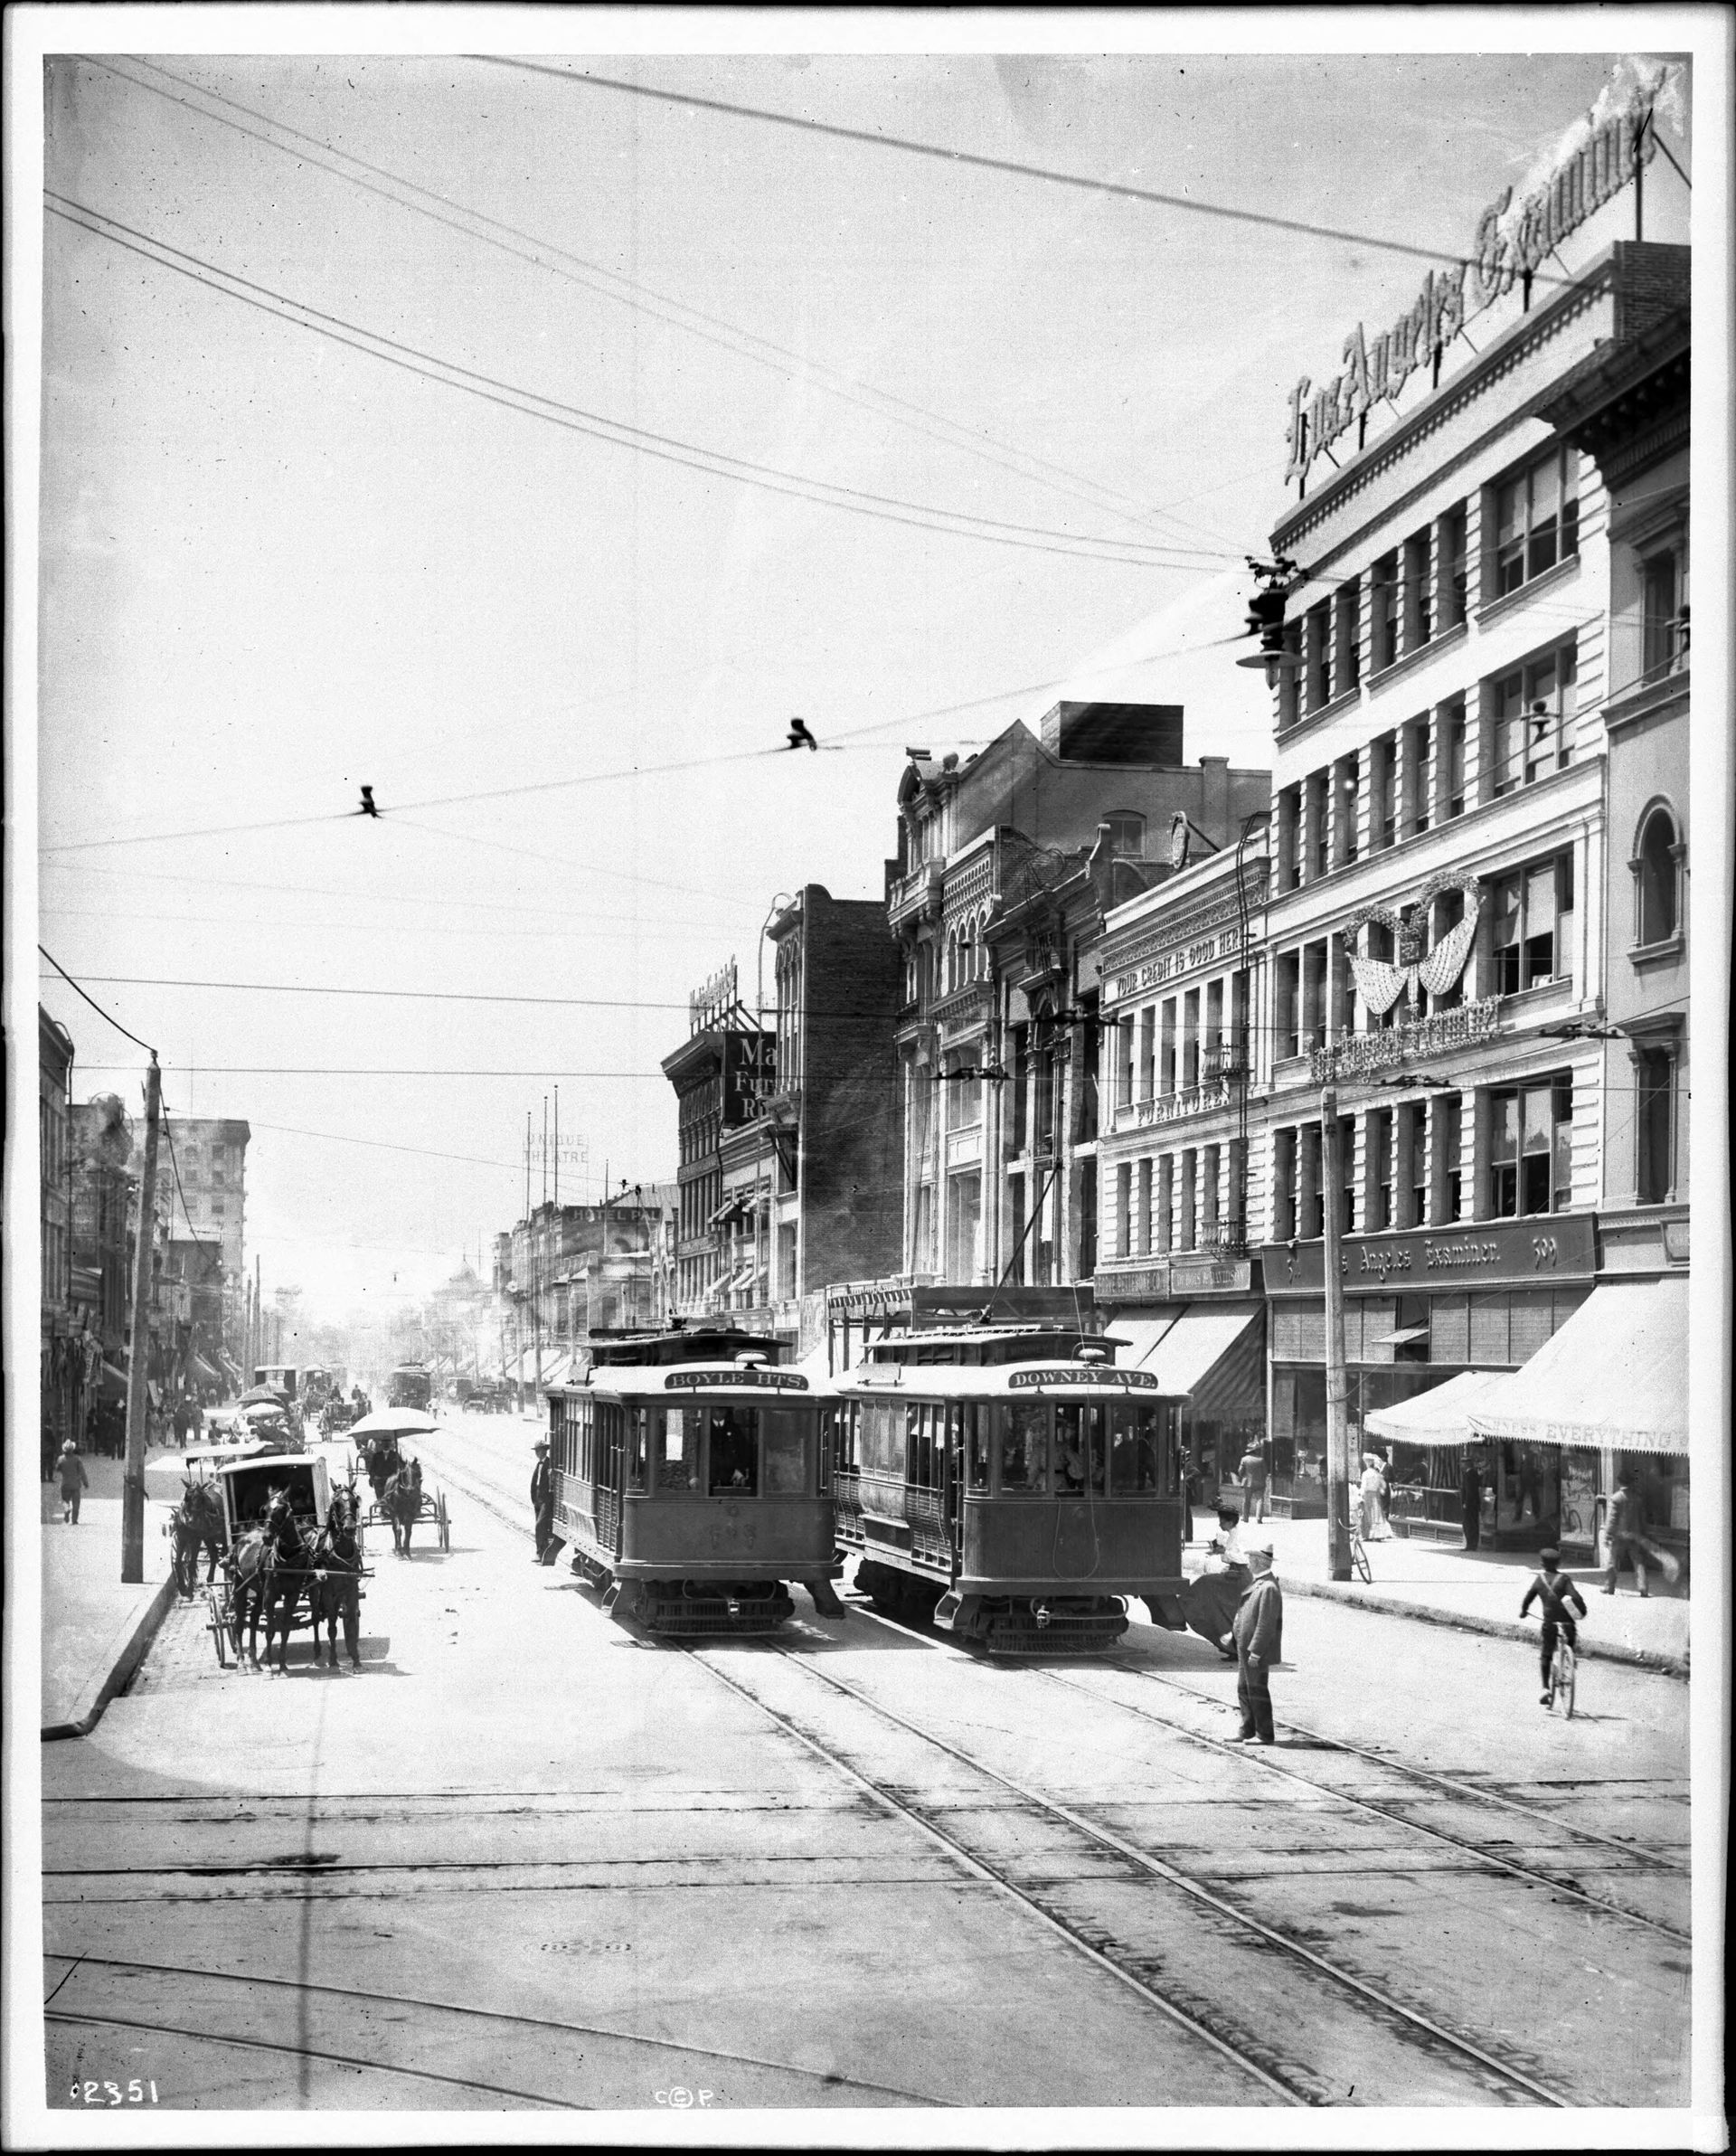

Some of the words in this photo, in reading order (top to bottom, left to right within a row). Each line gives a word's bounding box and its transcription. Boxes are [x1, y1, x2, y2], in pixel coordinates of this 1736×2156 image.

[1141, 956, 1173, 987] CREDIT
[1175, 951, 1185, 973] IS
[672, 1373, 745, 1387] BOYLE
[757, 1373, 806, 1389] HTS.
[1014, 1370, 1103, 1386] DOWNEY
[1110, 1372, 1156, 1388] AVE.
[1546, 1423, 1672, 1449] EVERYTHING
